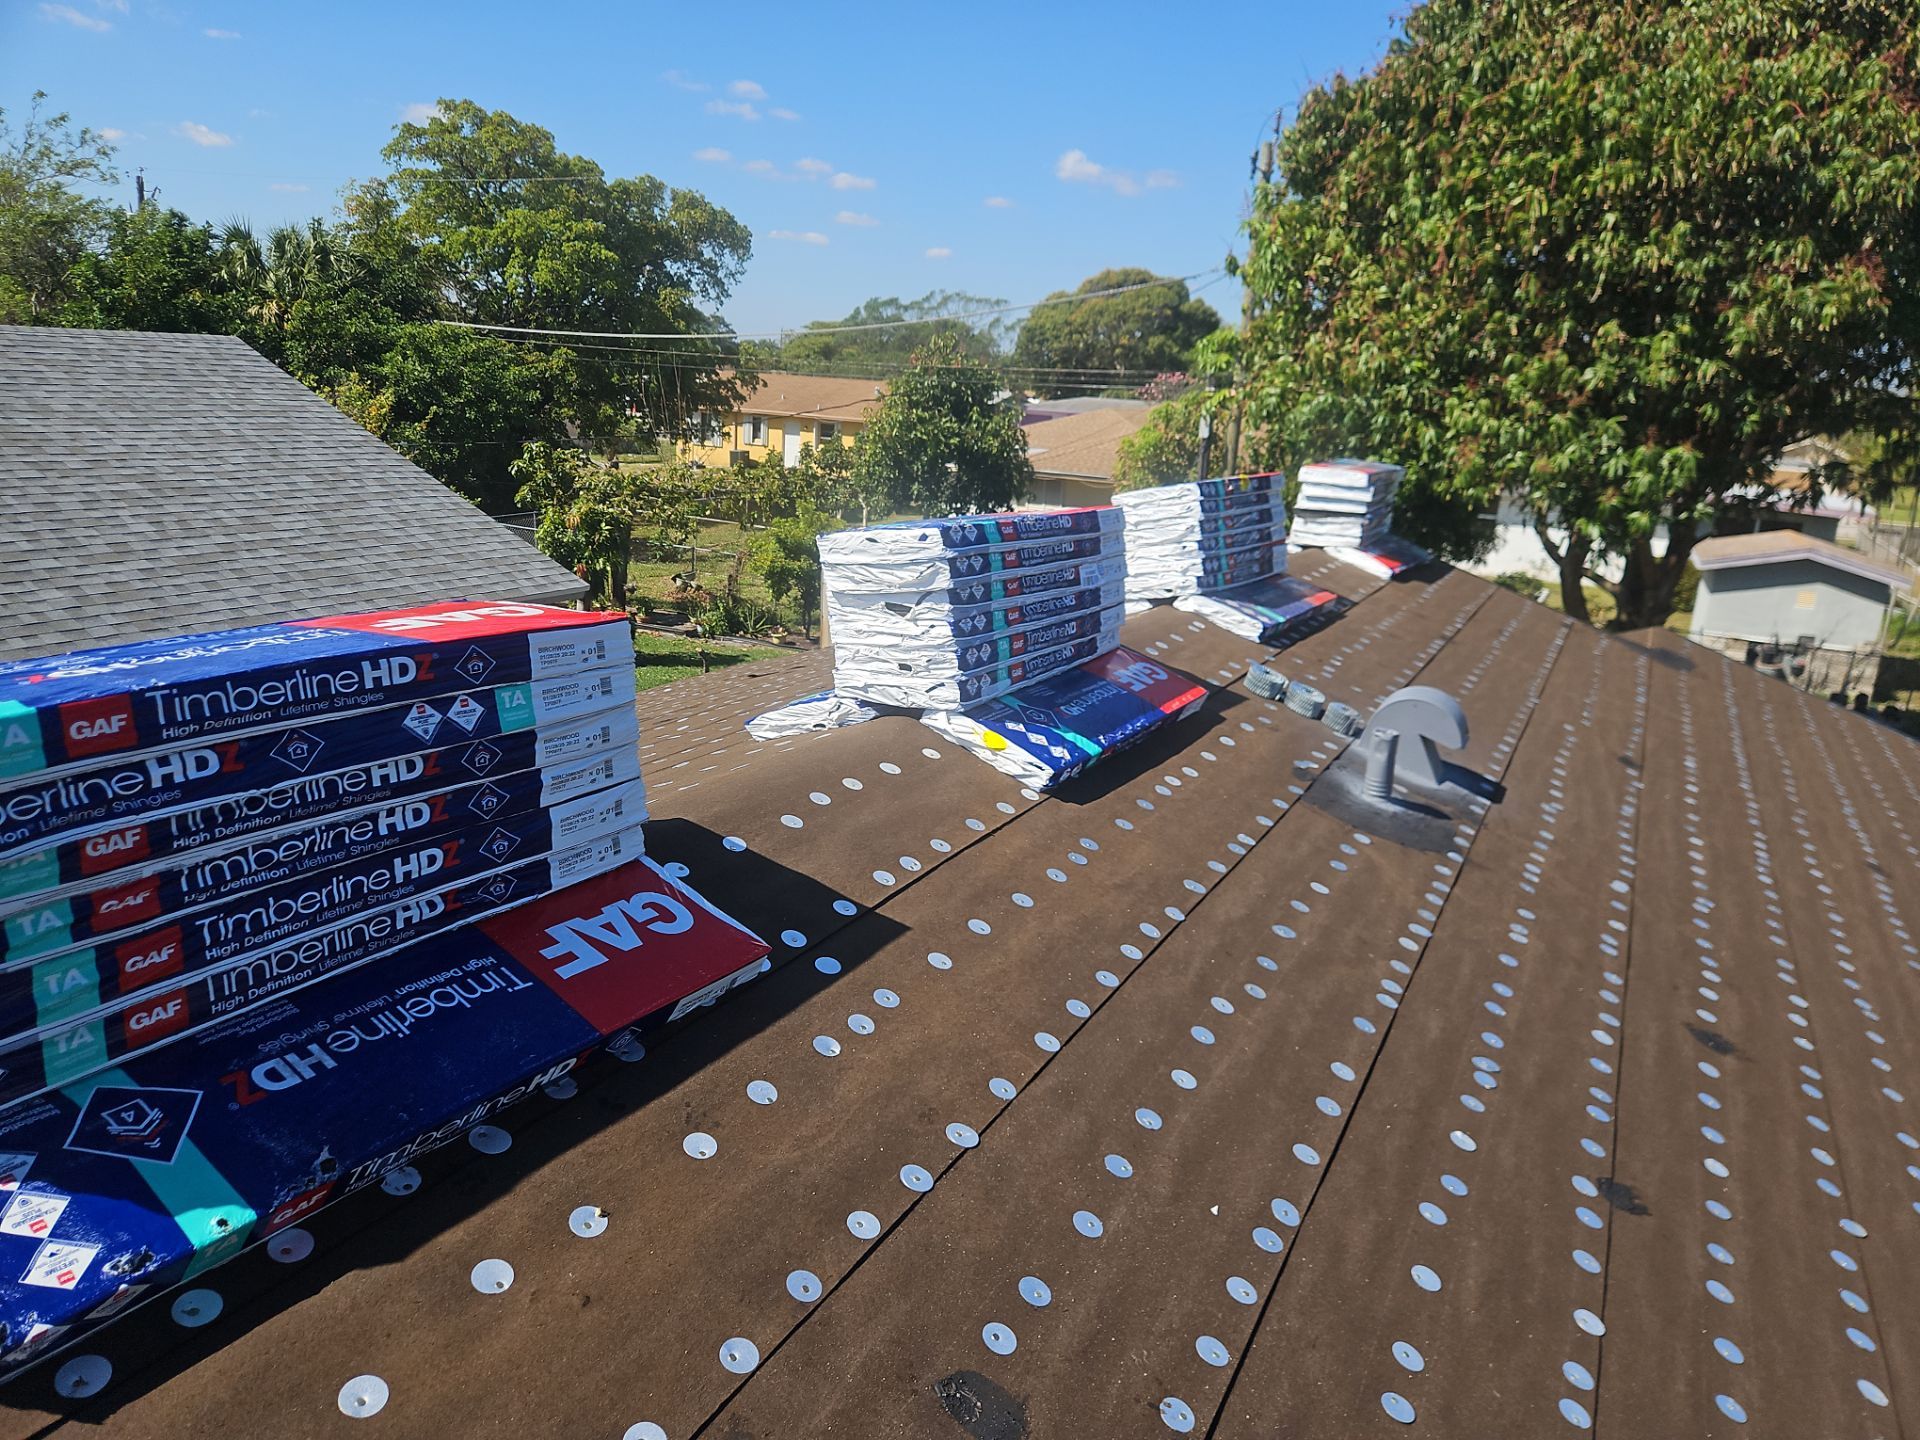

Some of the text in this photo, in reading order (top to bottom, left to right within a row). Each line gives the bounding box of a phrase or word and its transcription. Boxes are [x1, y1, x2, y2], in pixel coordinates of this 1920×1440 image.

[588, 647, 597, 655] 01
[1113, 662, 1169, 693] GAF
[501, 690, 526, 708] TA
[69, 714, 128, 742] GAF
[162, 690, 384, 740] High Definition Lifetime Shingles
[0, 722, 32, 748] A
[593, 733, 601, 741] 01
[596, 767, 604, 775] 01
[42, 788, 182, 834] Lifetime Shingles
[173, 787, 391, 850] High Definition Lifetime Shingles
[605, 807, 615, 815] 01
[85, 827, 143, 859] GAF
[296, 850, 346, 871] Lifetime
[350, 837, 400, 857] Shingles
[604, 845, 613, 853] 01
[99, 888, 153, 915] GAF
[15, 911, 63, 936] TA
[206, 883, 415, 960] High Definition Lifetime Shingles
[539, 892, 695, 980] GAF
[124, 943, 177, 973] GAF
[211, 928, 416, 1015] High Definition Lifetime Shingles
[461, 955, 497, 974] High
[44, 967, 89, 994] TA
[395, 967, 461, 996] Definition
[128, 1000, 183, 1031] GAF
[53, 1026, 96, 1053] TA
[258, 1020, 330, 1053] Shingles
[272, 1190, 328, 1225] GAF
